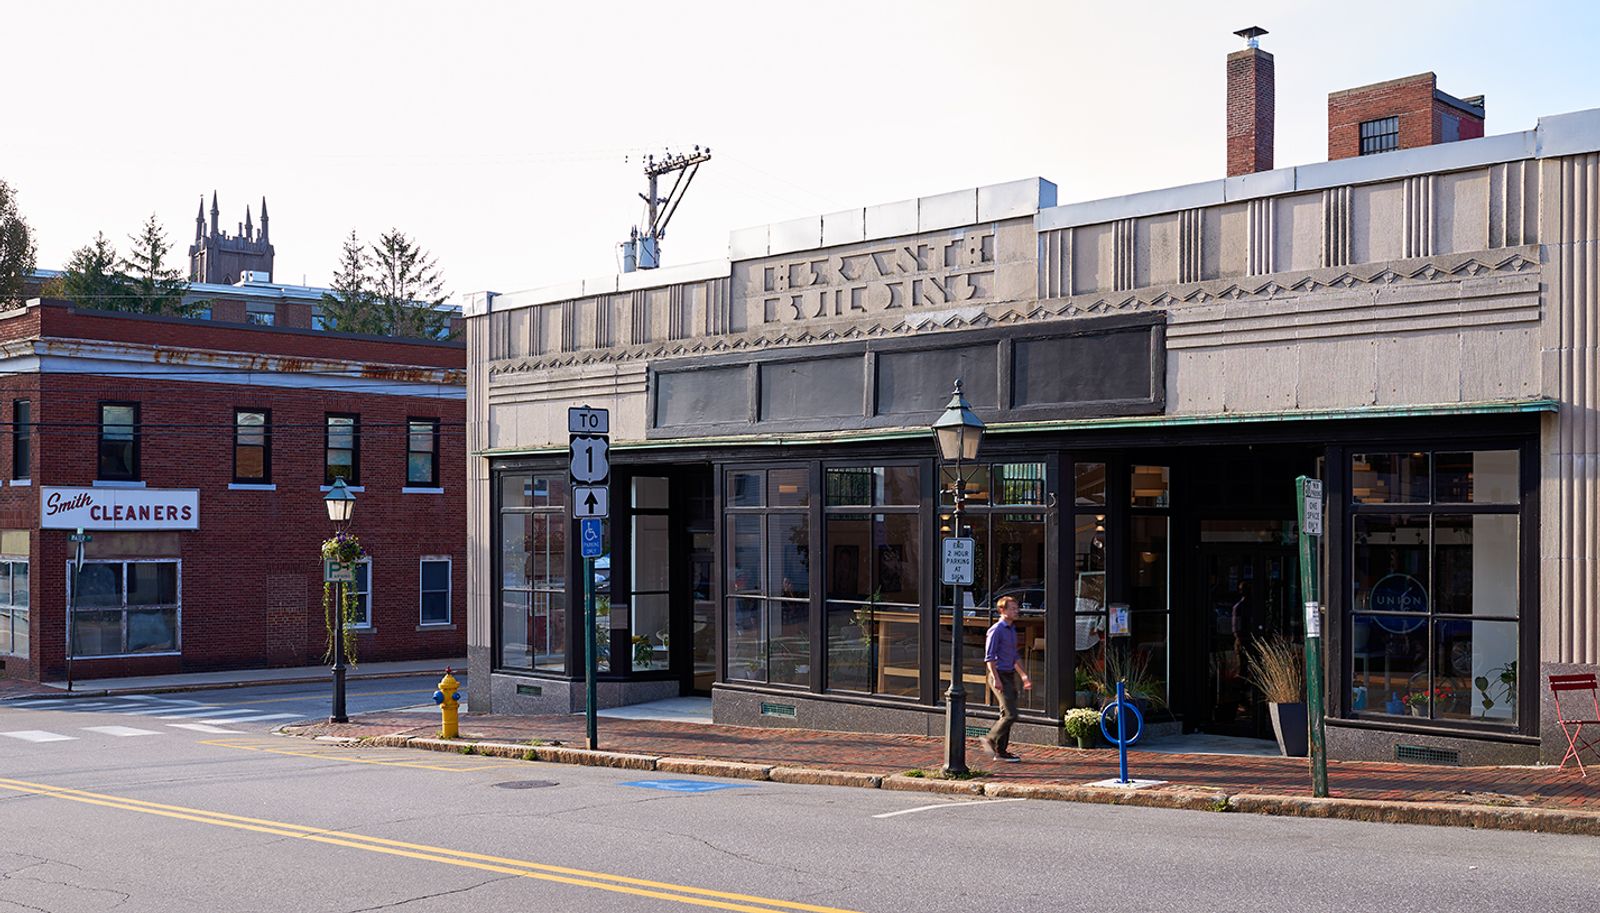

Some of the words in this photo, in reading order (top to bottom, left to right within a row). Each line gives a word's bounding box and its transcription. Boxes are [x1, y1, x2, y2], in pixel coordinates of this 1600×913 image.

[779, 273, 977, 320] BUILDING
[579, 413, 599, 428] TO
[585, 446, 593, 473] 1
[46, 492, 94, 516] Smith
[90, 504, 192, 521] CLEANERS
[329, 562, 342, 578] P
[1376, 595, 1421, 605] UNION
